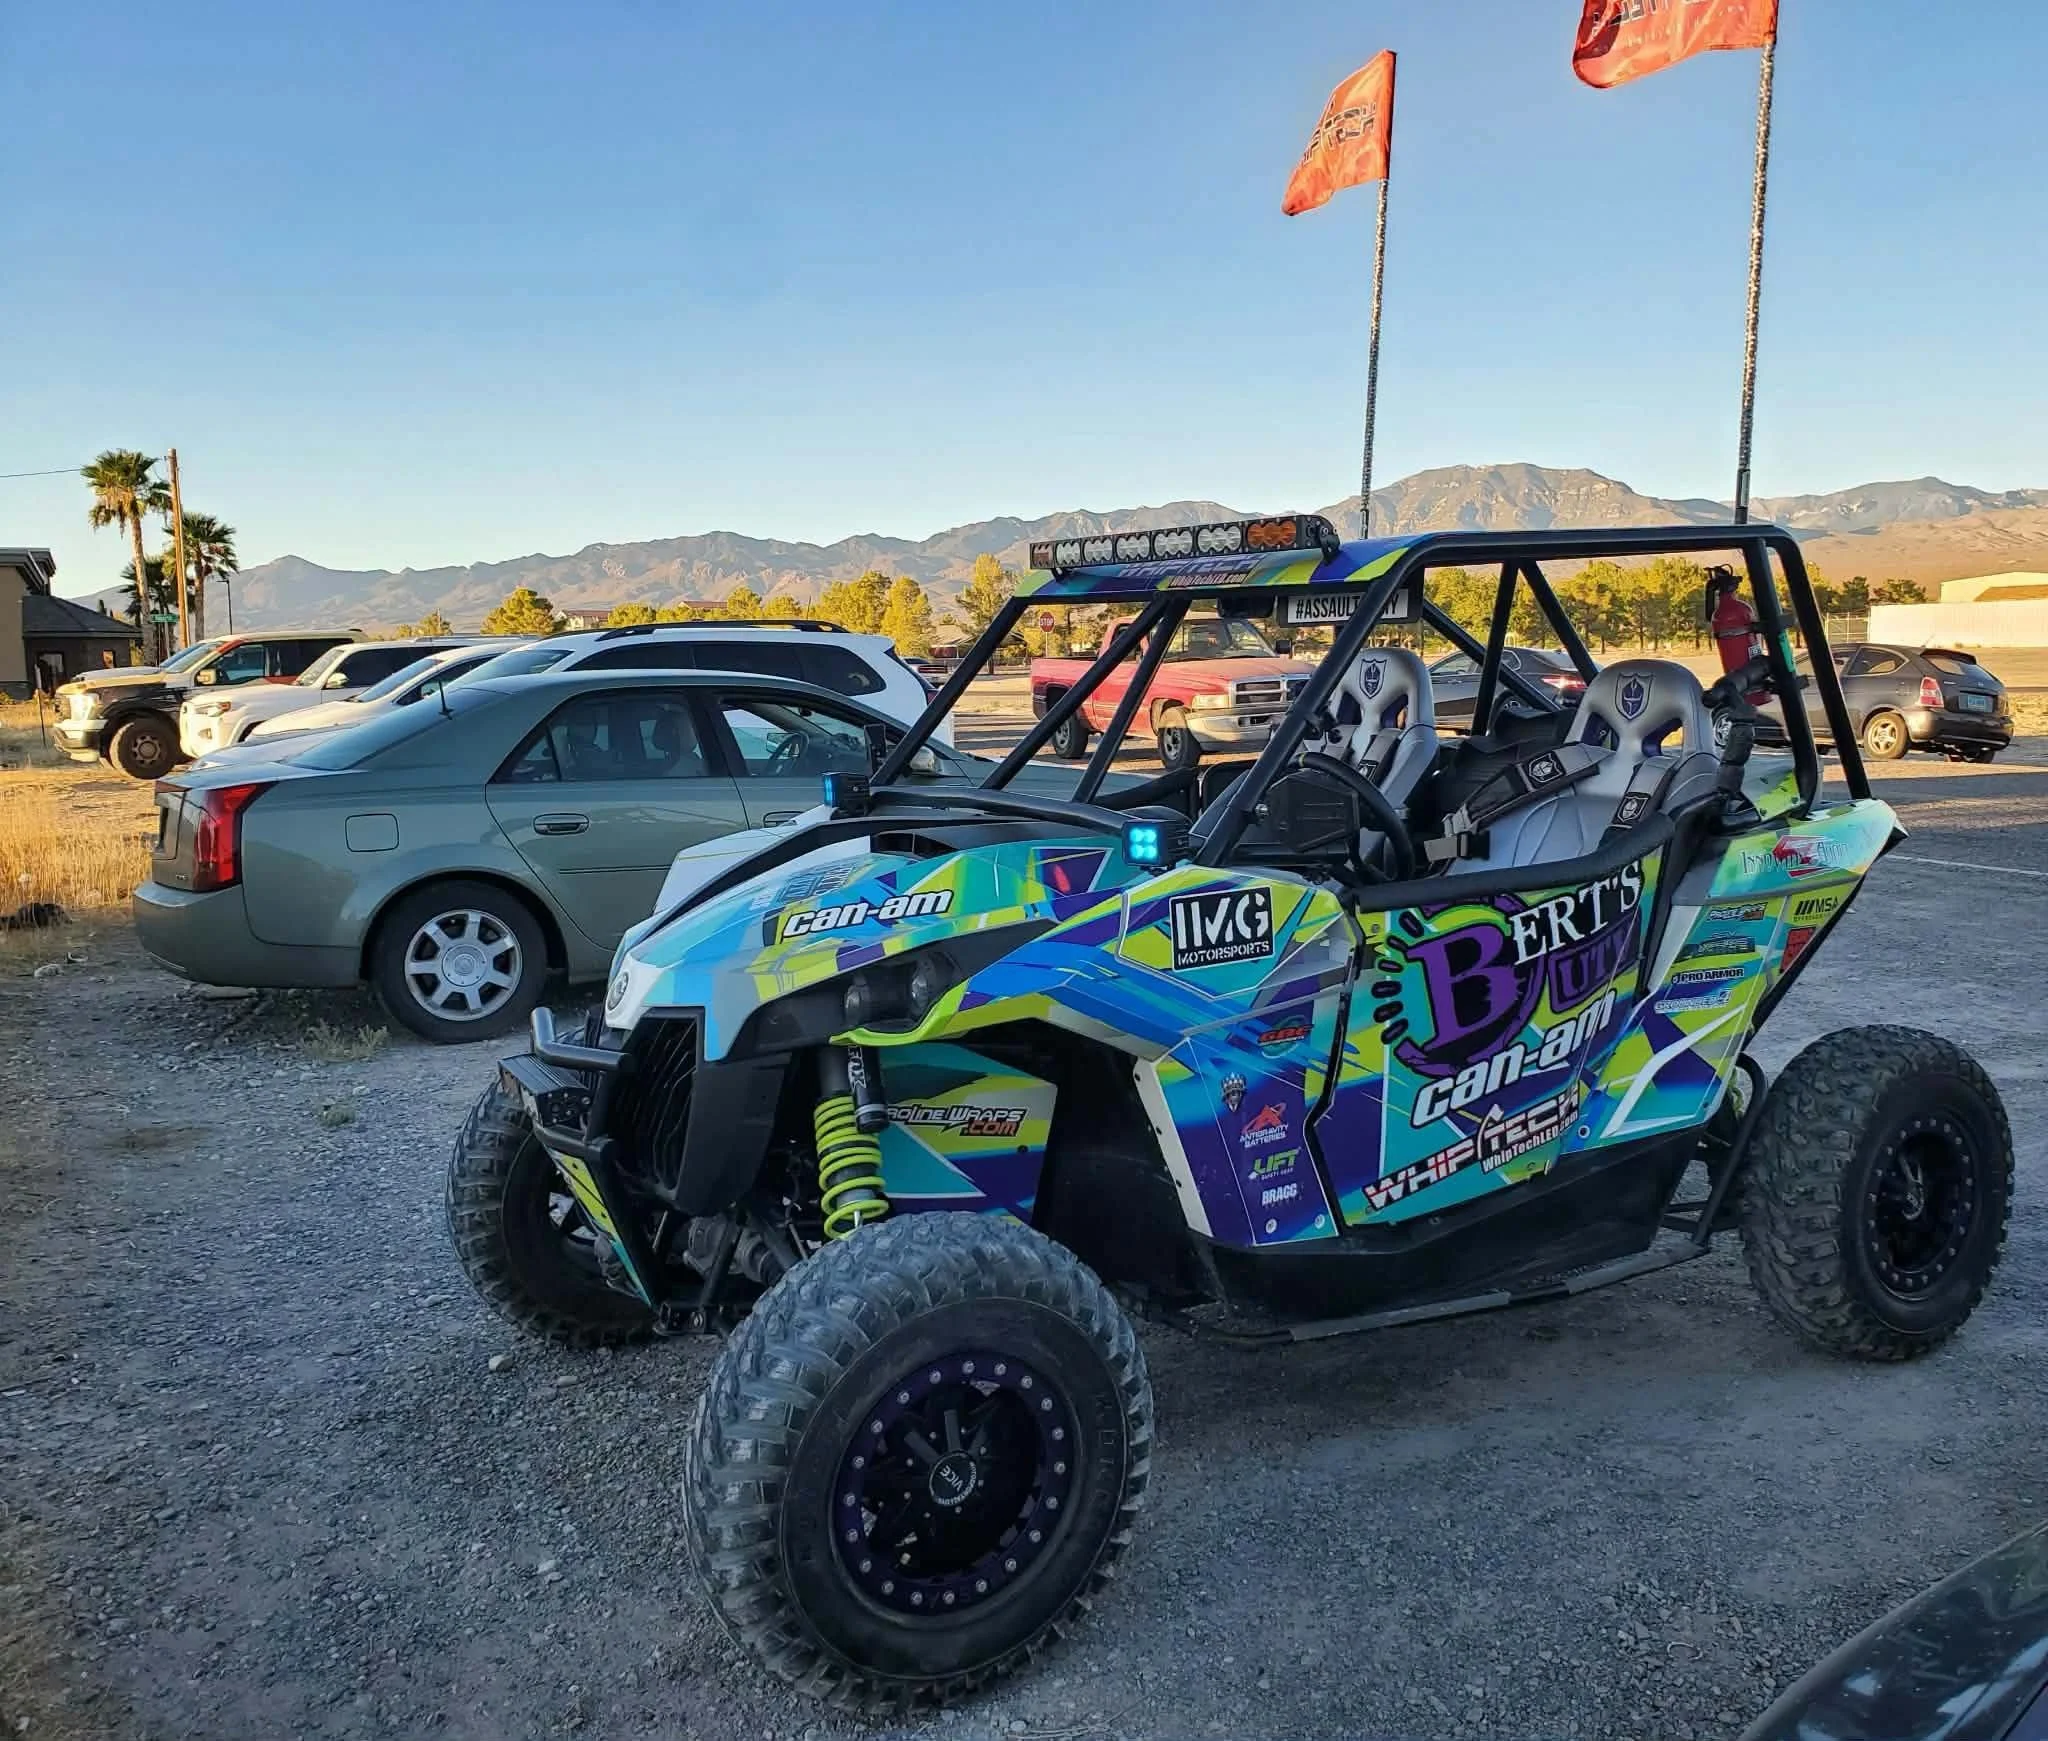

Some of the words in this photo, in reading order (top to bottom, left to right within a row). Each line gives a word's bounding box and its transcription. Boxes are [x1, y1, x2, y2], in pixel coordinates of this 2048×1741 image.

[1040, 617, 1054, 626] STOP
[1174, 891, 1270, 949] IMG
[1177, 940, 1270, 966] MOTORSPORTS
